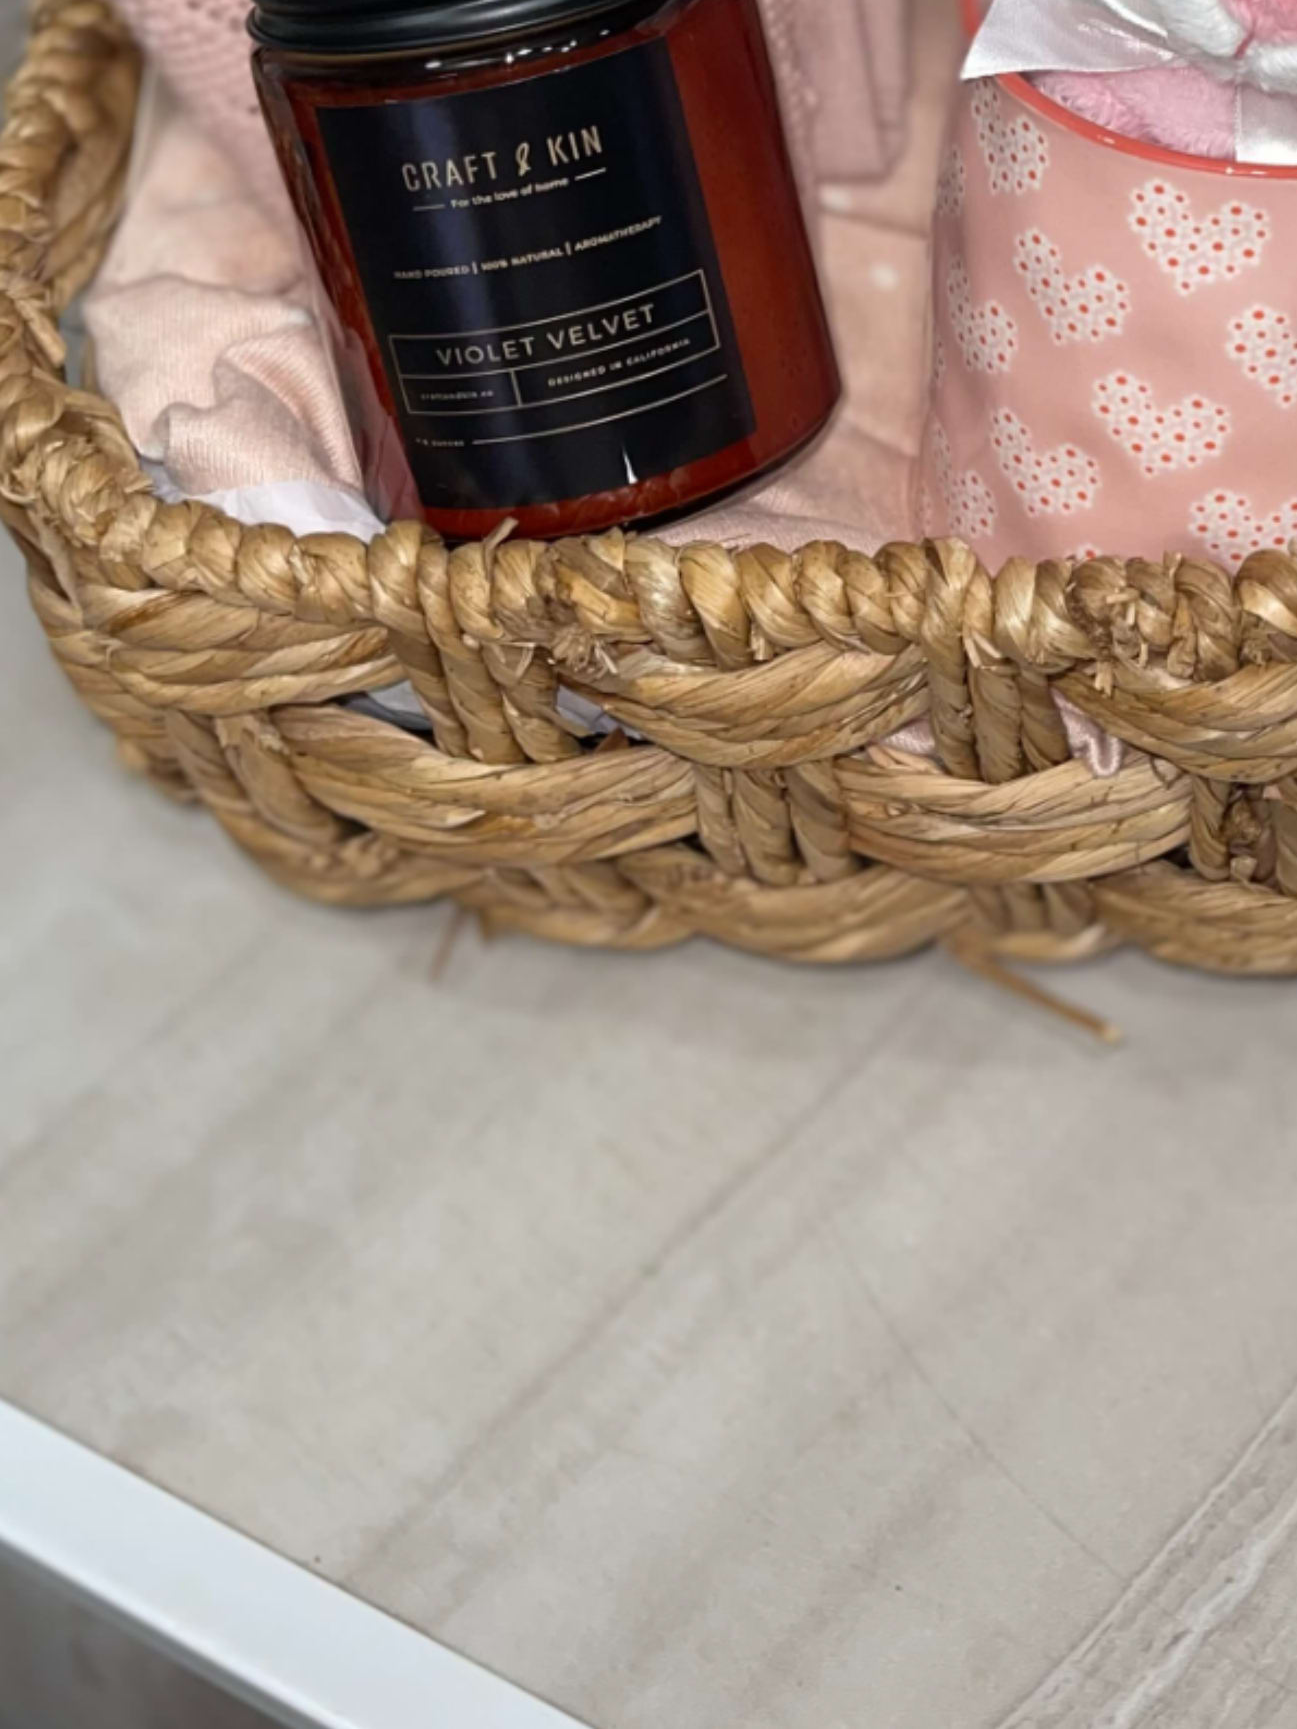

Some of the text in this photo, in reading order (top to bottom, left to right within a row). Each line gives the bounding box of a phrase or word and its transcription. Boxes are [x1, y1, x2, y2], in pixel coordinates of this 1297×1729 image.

[402, 125, 602, 192] CRAFT & KIN
[472, 194, 492, 206] the
[494, 189, 518, 201] love
[520, 183, 532, 196] of
[511, 247, 564, 266] NATURAL
[574, 215, 662, 251] AROMATHERAPY
[436, 303, 654, 366] VIOLET VELVET
[548, 338, 690, 386] DESIGNED IN CALIFORNIA
